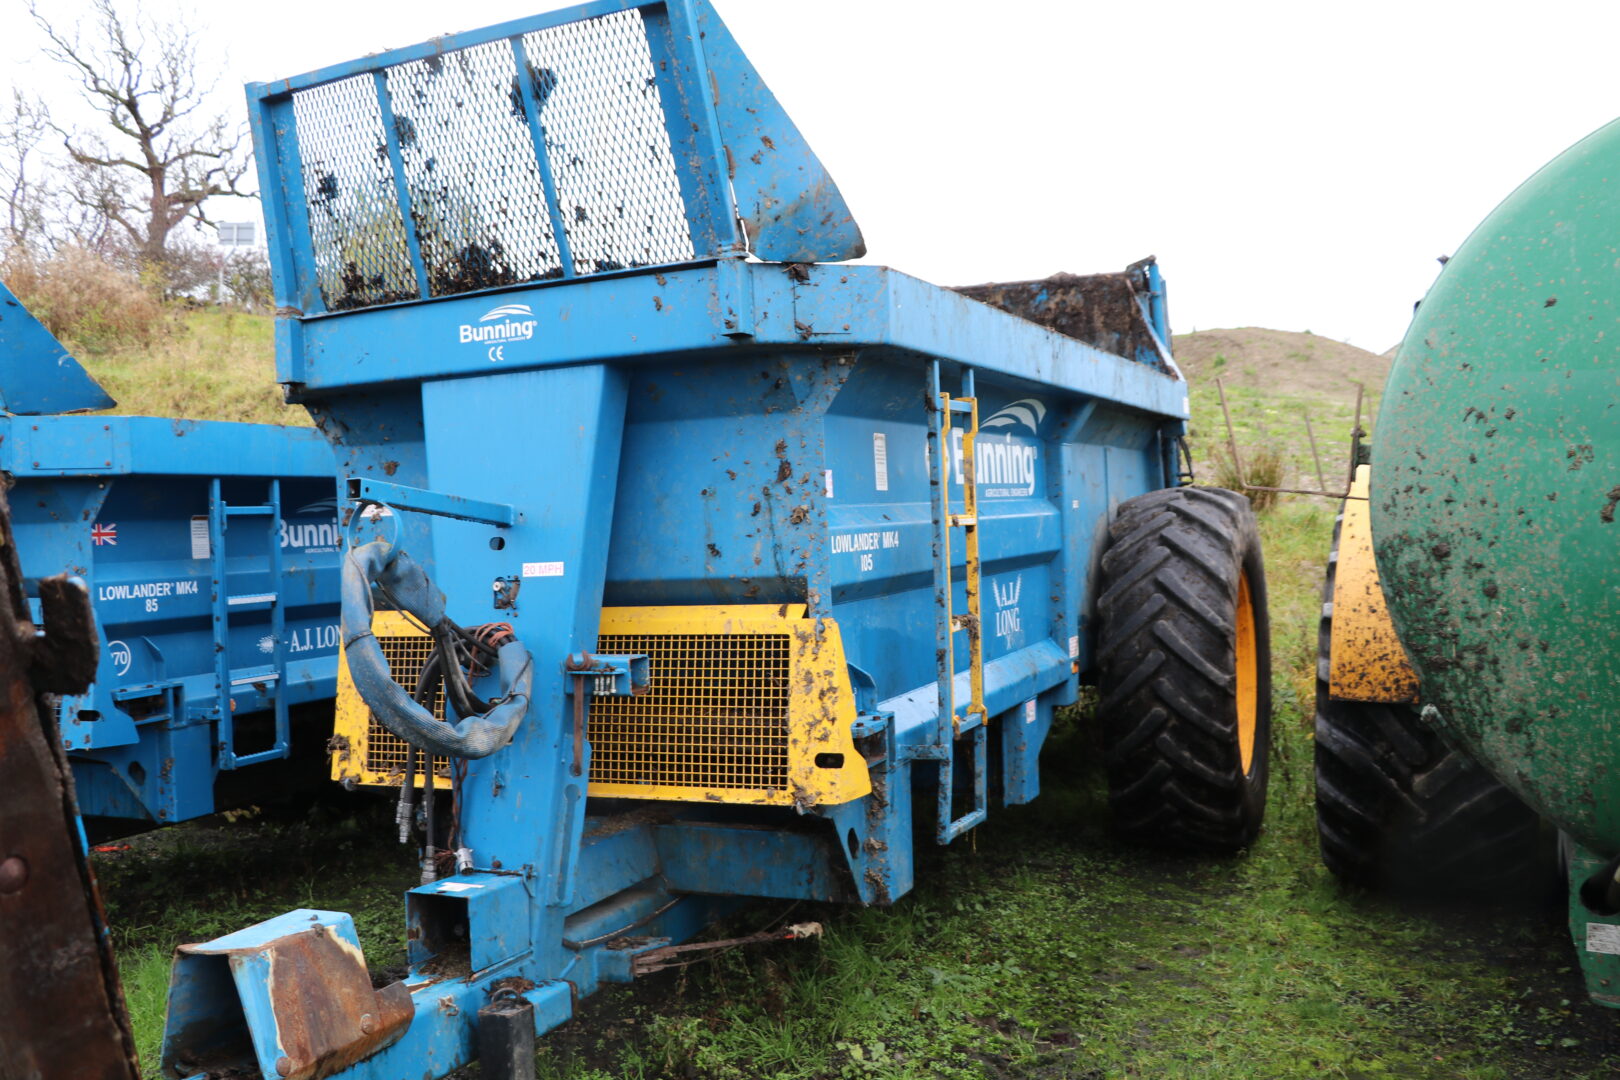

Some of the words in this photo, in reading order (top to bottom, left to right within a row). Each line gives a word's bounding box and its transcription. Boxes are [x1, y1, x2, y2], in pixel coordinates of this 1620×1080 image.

[459, 319, 538, 344] Bunning
[952, 427, 1036, 496] Bnning
[280, 517, 338, 548] Bunni
[831, 532, 880, 554] LOWLANDER
[882, 531, 900, 549] MK4
[524, 565, 536, 576] 20
[538, 563, 562, 575] MPH
[861, 554, 873, 572] 105
[99, 582, 172, 601] LOWLANDER
[176, 580, 199, 595] MK4
[145, 598, 159, 613] 85
[996, 607, 1020, 637] LONG
[111, 651, 128, 666] 70
